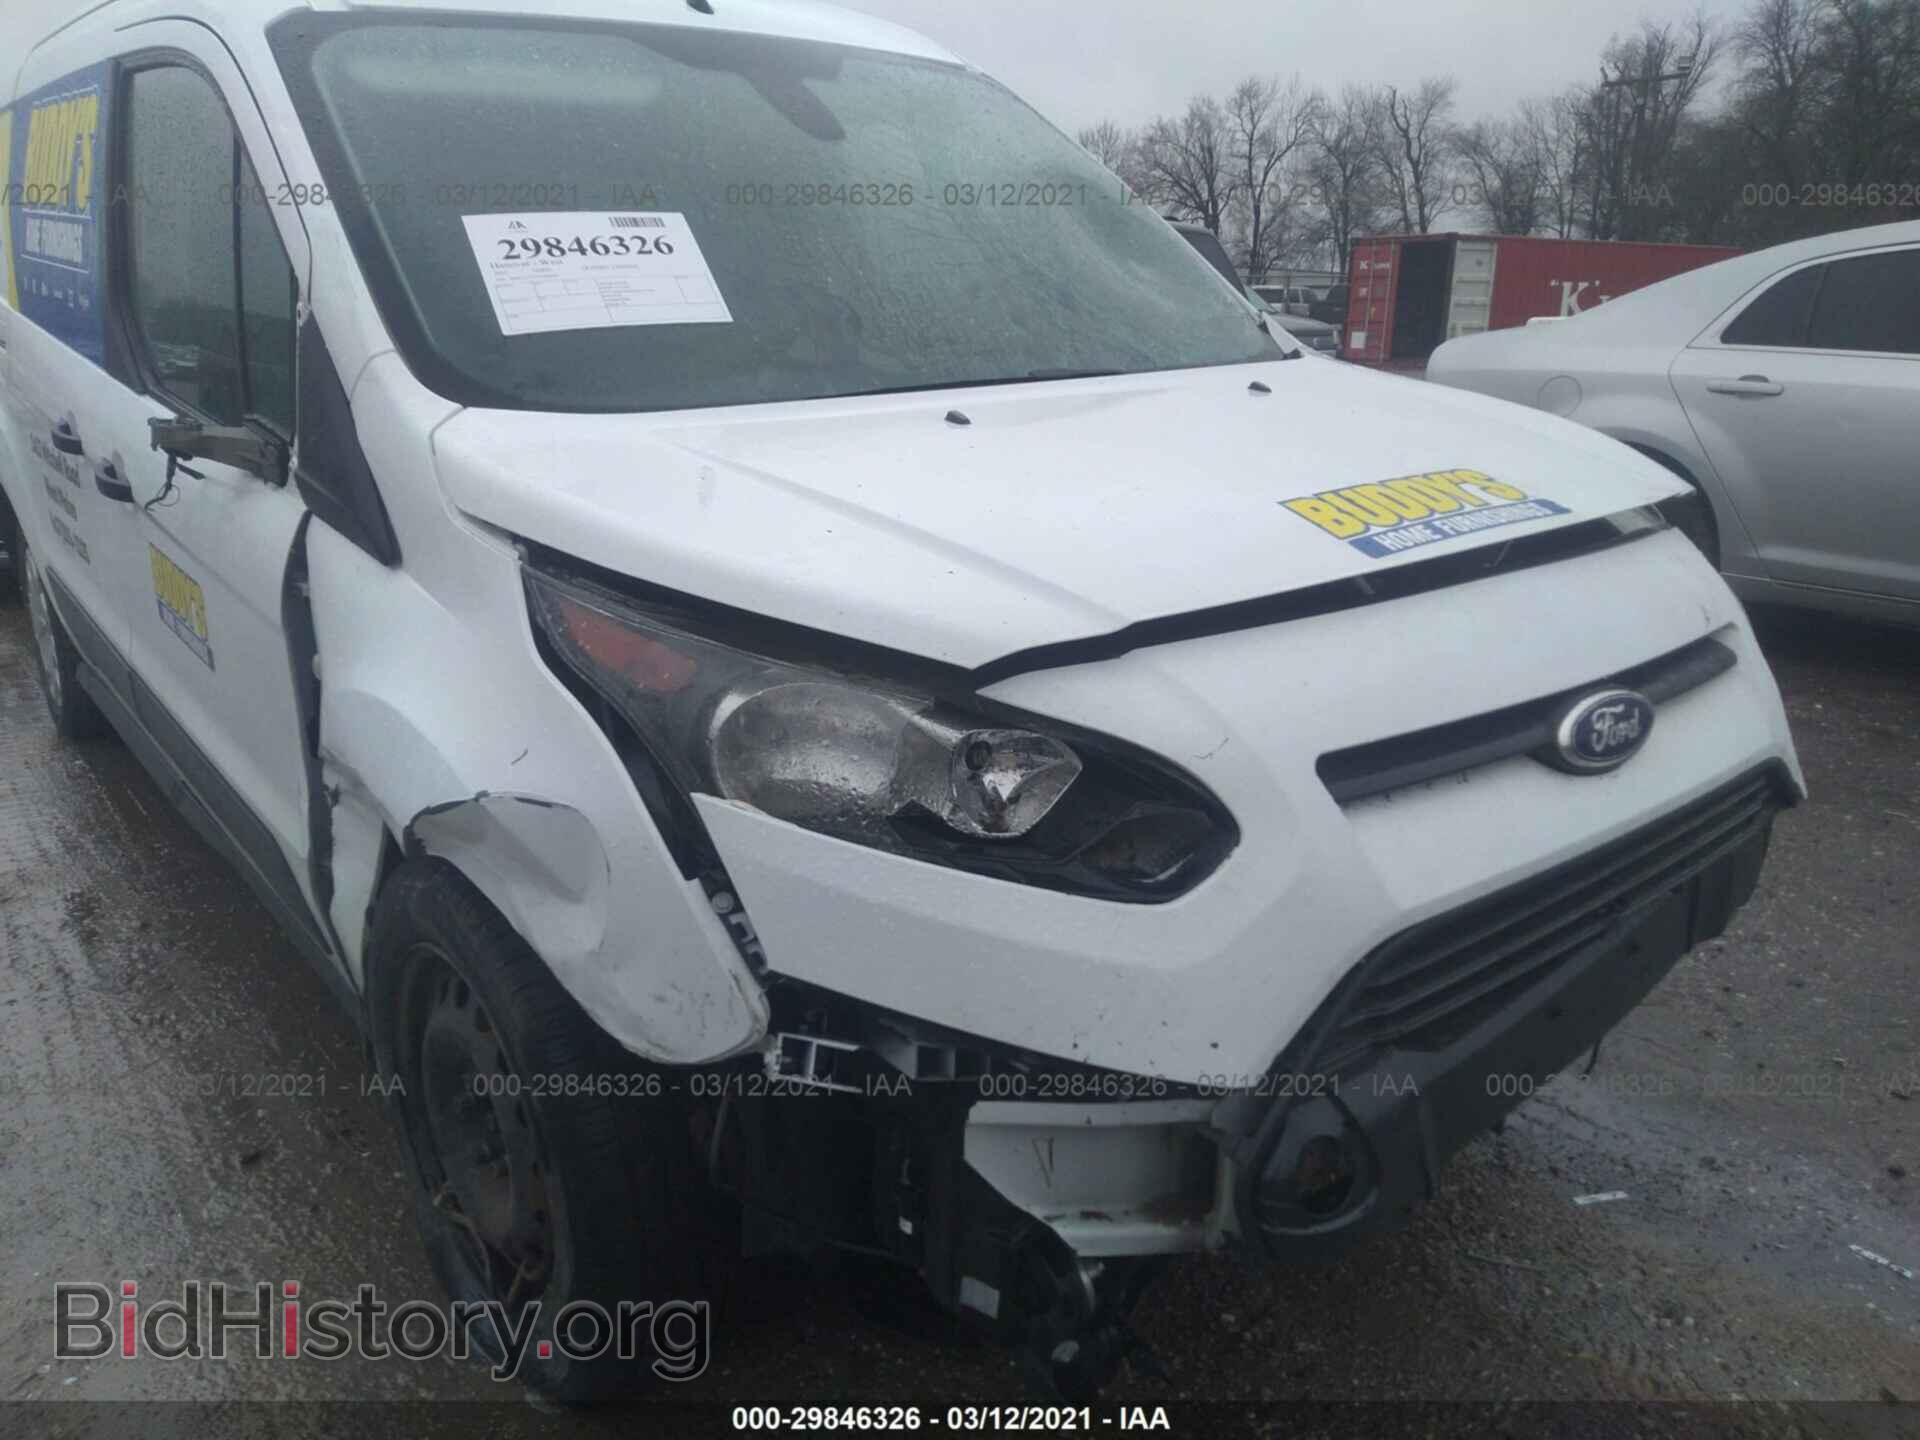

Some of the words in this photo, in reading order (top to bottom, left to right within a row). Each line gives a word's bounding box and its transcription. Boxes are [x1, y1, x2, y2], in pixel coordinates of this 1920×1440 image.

[497, 235, 675, 260] 29846326
[1277, 468, 1529, 540] BUDDY'S
[1373, 523, 1442, 551] HOME
[1591, 703, 1640, 752] Ford
